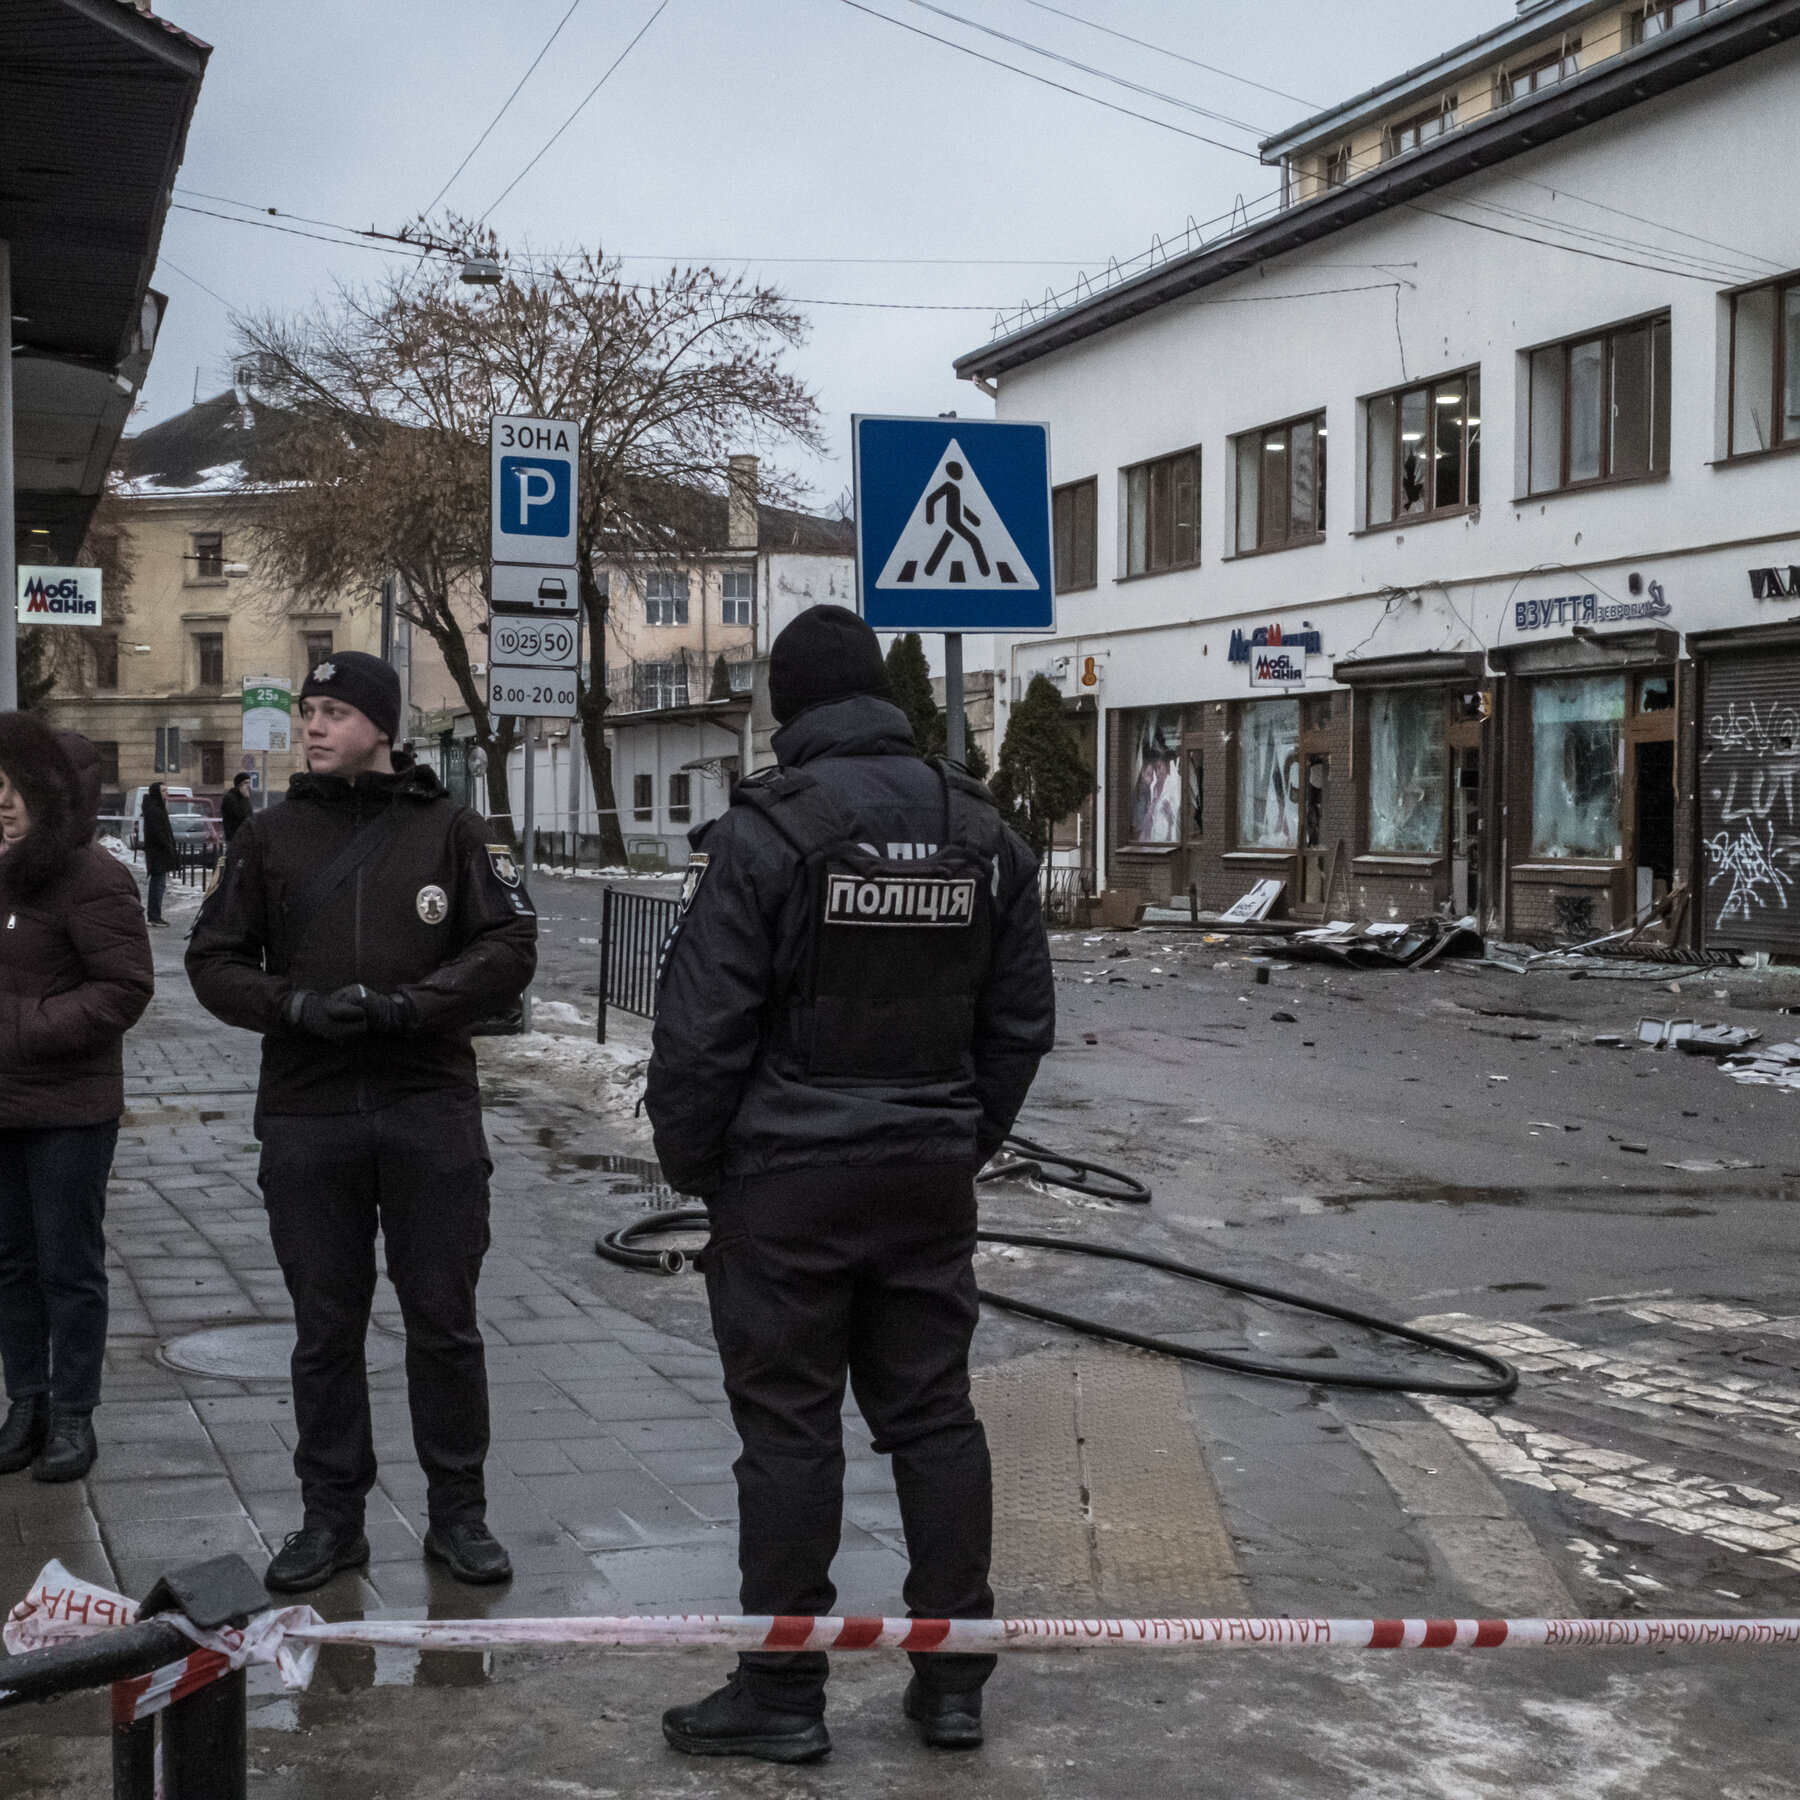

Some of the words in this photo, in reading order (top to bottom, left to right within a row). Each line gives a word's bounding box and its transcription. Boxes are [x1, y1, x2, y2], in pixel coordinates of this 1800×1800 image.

[500, 425, 570, 452] ЗОНА
[24, 576, 78, 599] Мобі
[27, 591, 96, 614] Манія
[1515, 593, 1596, 629] ВЗУТТЯ
[501, 634, 515, 647] 10
[520, 634, 538, 649] 25
[544, 633, 568, 651] 50
[831, 881, 971, 921] ПОЛІЦІЯ
